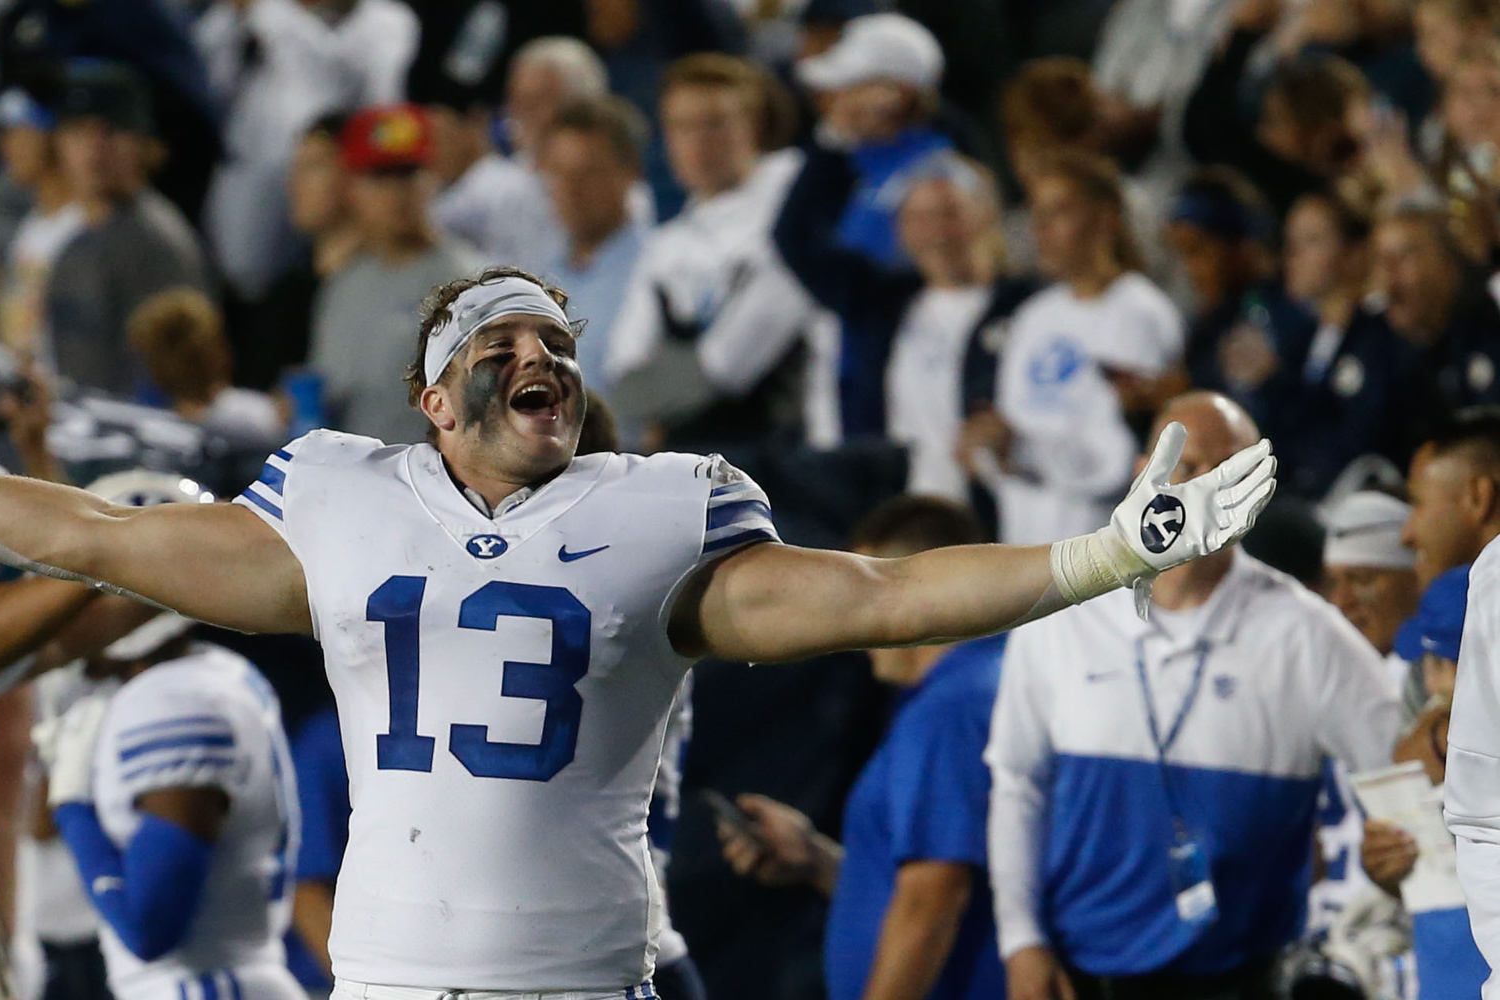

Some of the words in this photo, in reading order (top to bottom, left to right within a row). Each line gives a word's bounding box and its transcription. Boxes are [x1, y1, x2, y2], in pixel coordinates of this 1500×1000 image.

[472, 537, 502, 556] Y
[1143, 505, 1184, 548] Y
[365, 574, 592, 783] 13
